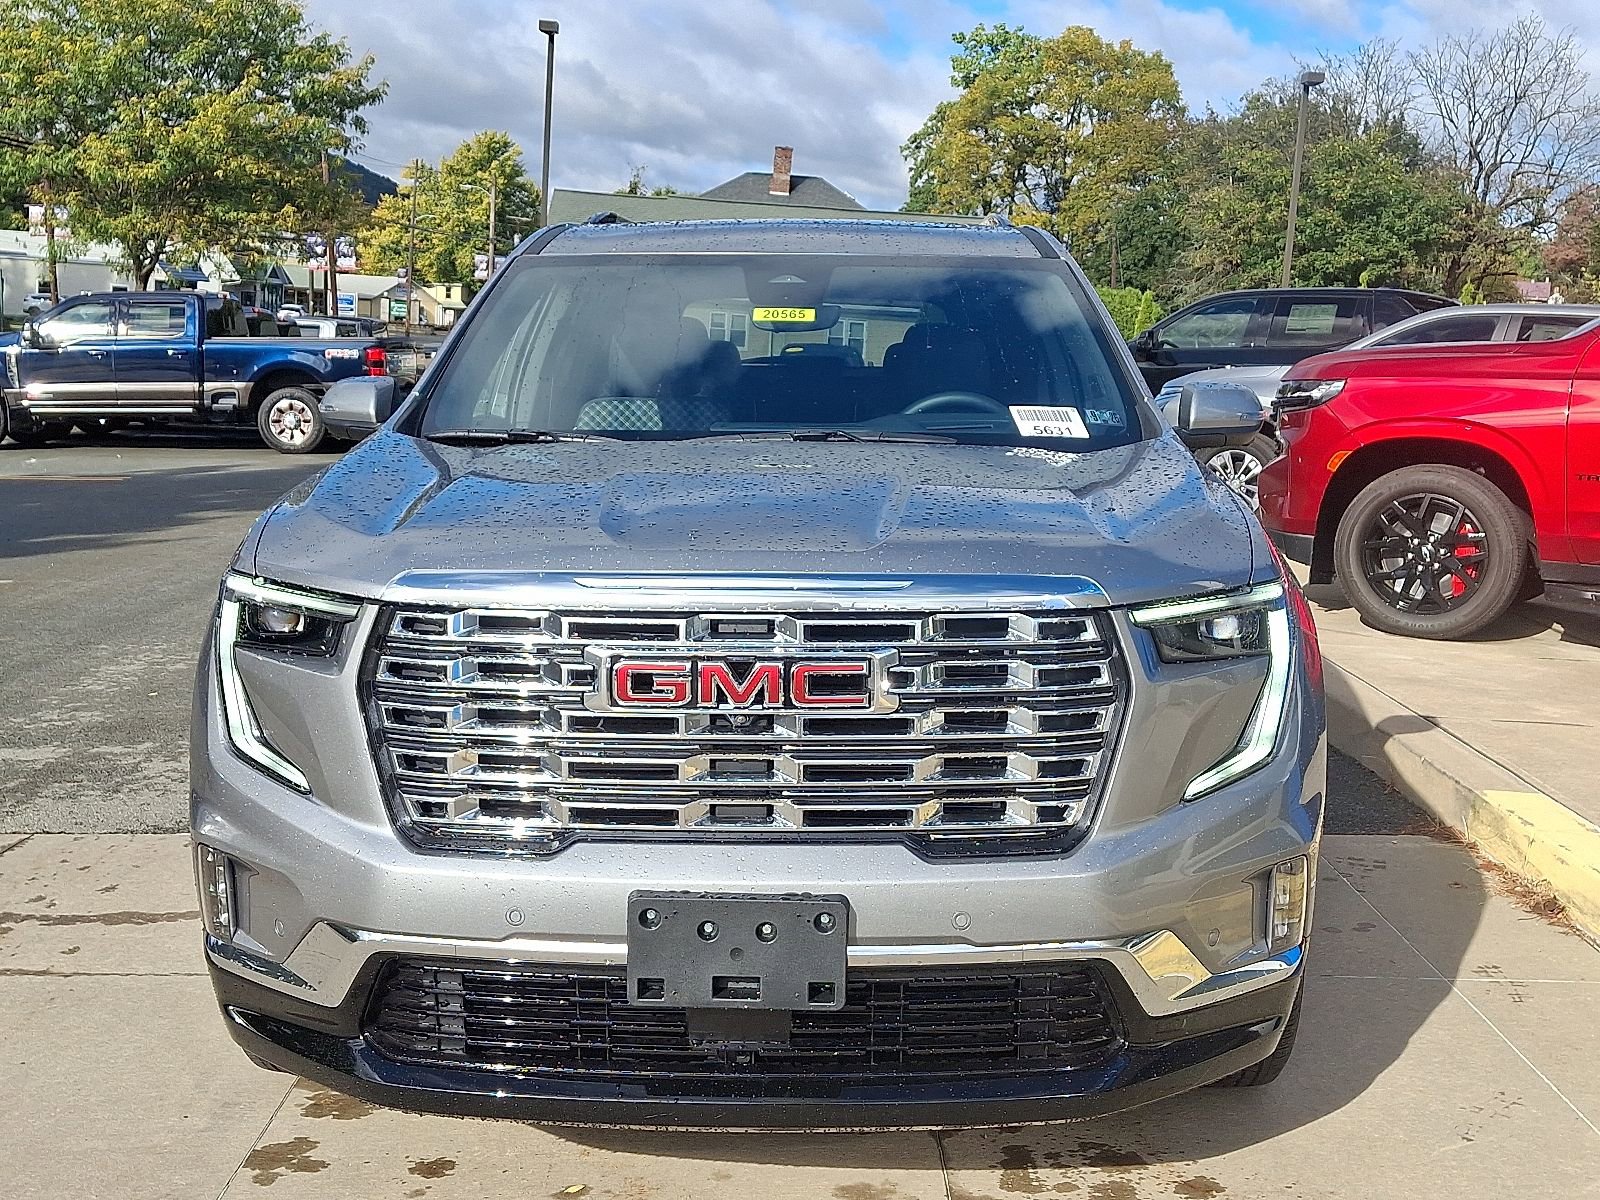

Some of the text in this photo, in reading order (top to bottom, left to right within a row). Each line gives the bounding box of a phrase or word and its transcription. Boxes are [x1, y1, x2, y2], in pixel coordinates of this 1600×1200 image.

[763, 309, 806, 319] 20565
[1033, 425, 1073, 436] 5631
[613, 660, 870, 709] GMC
